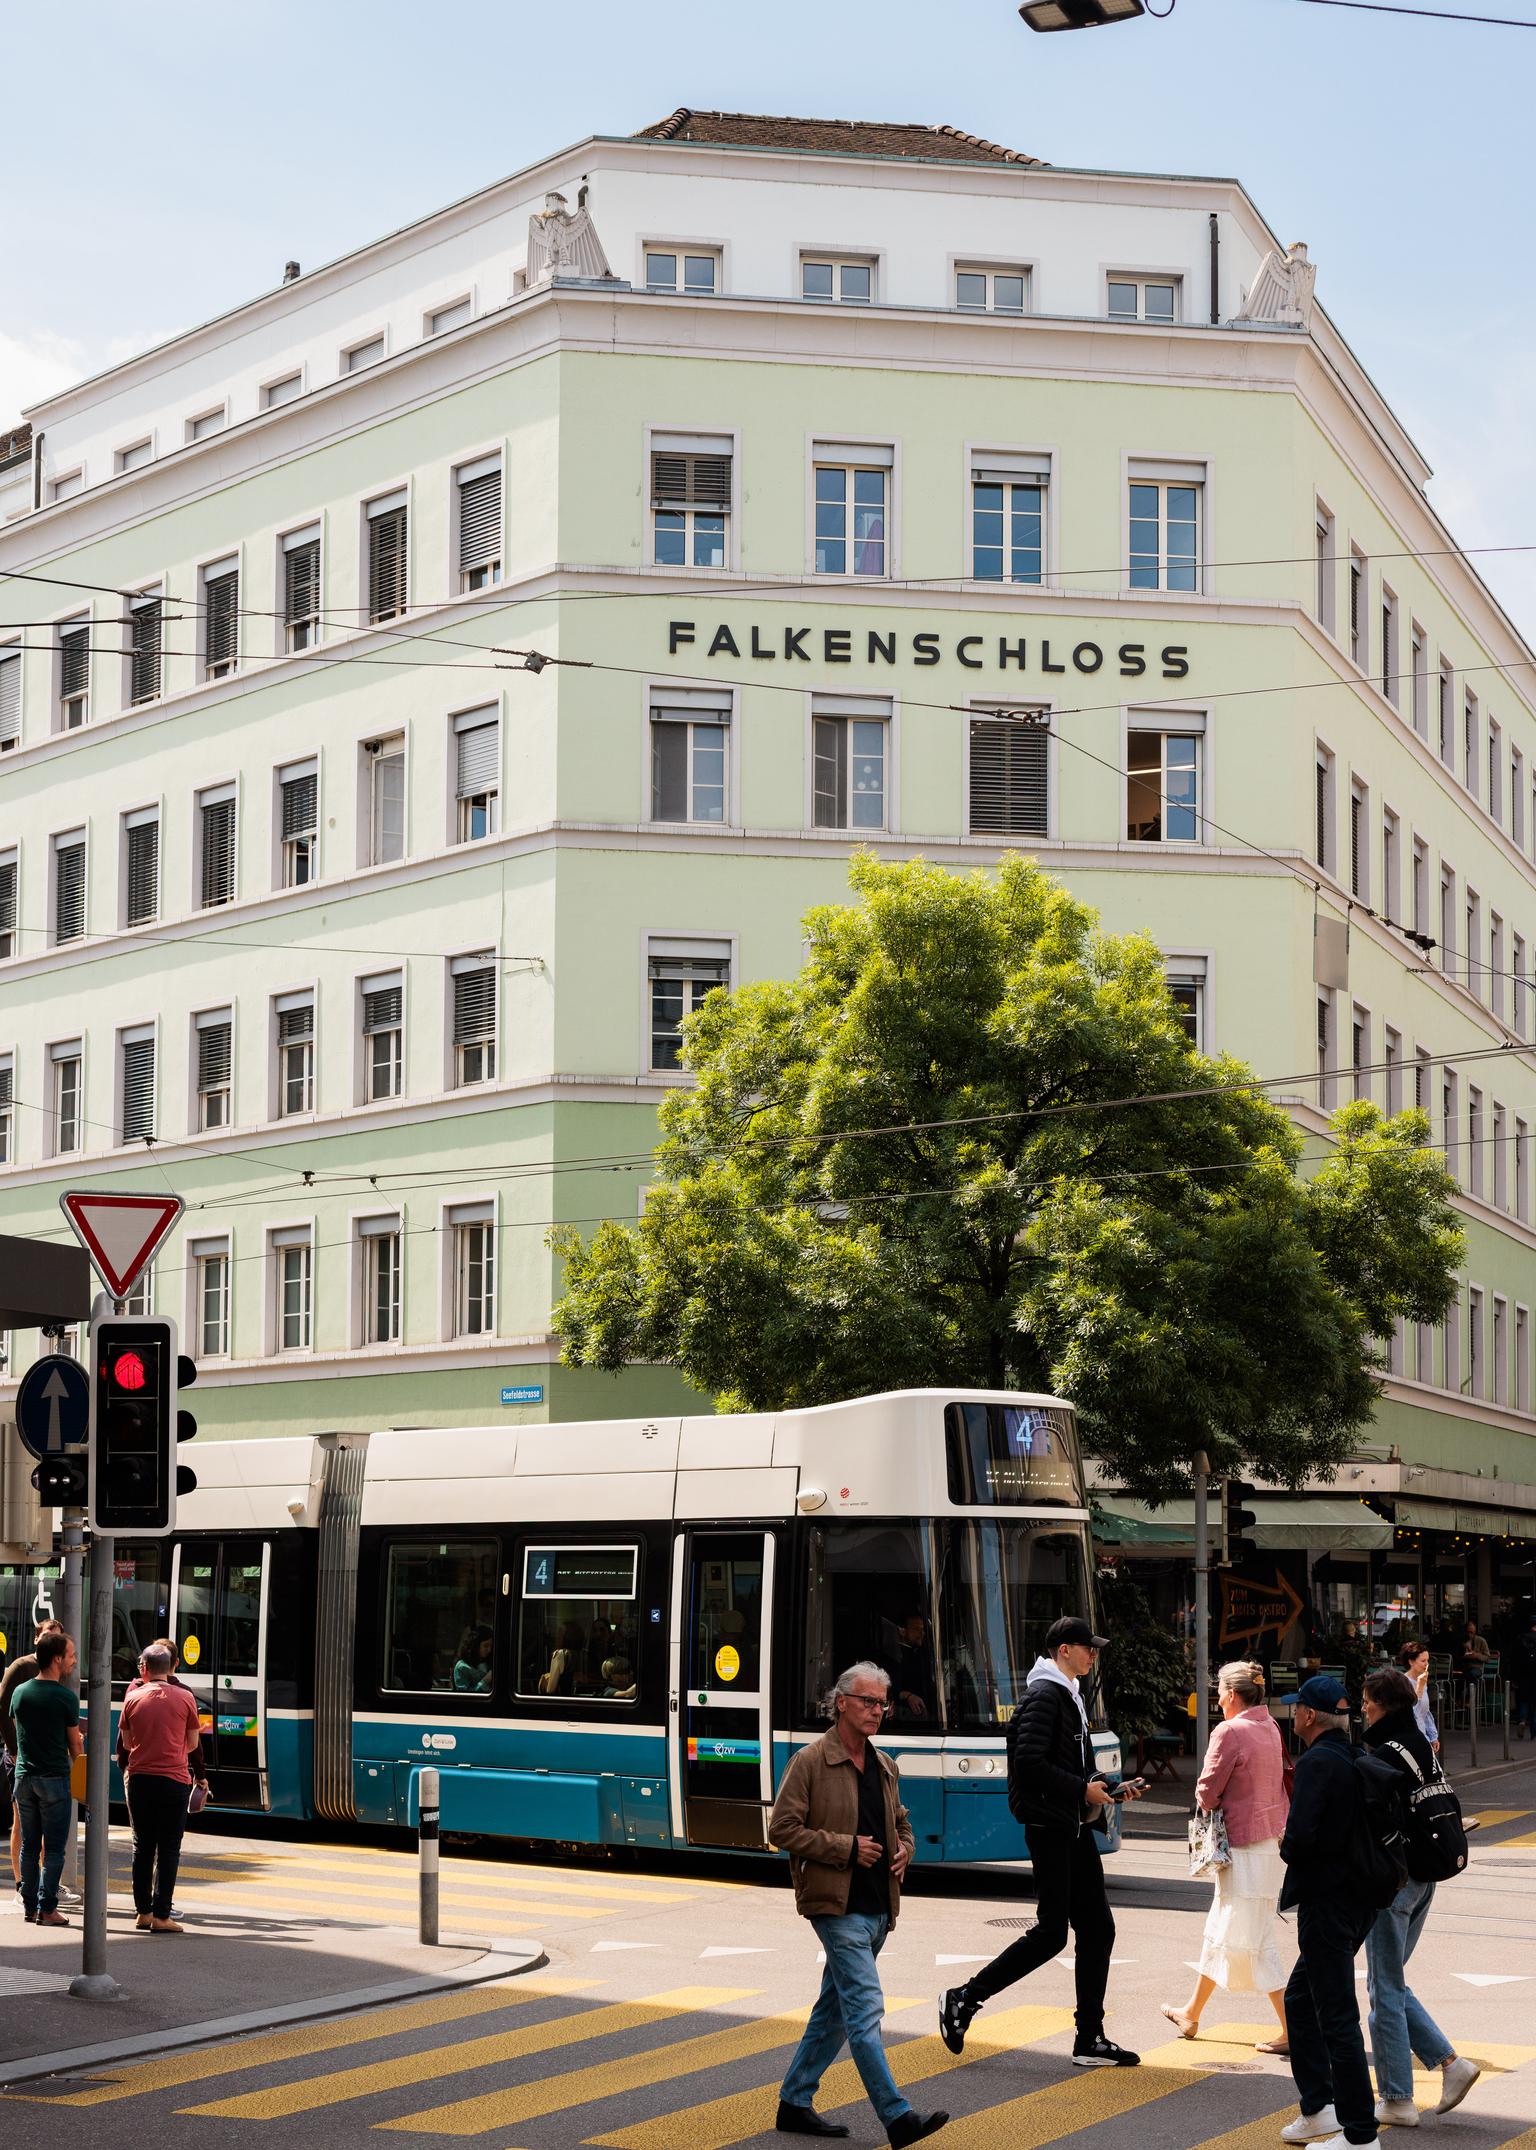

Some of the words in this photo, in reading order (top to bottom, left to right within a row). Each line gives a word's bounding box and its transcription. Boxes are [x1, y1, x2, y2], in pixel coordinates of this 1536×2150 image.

[669, 621, 1189, 678] FALKENSCHLOSS
[502, 1390, 540, 1400] Seefeldstrasse
[1016, 1415, 1033, 1450] 4
[535, 1559, 548, 1585] 4
